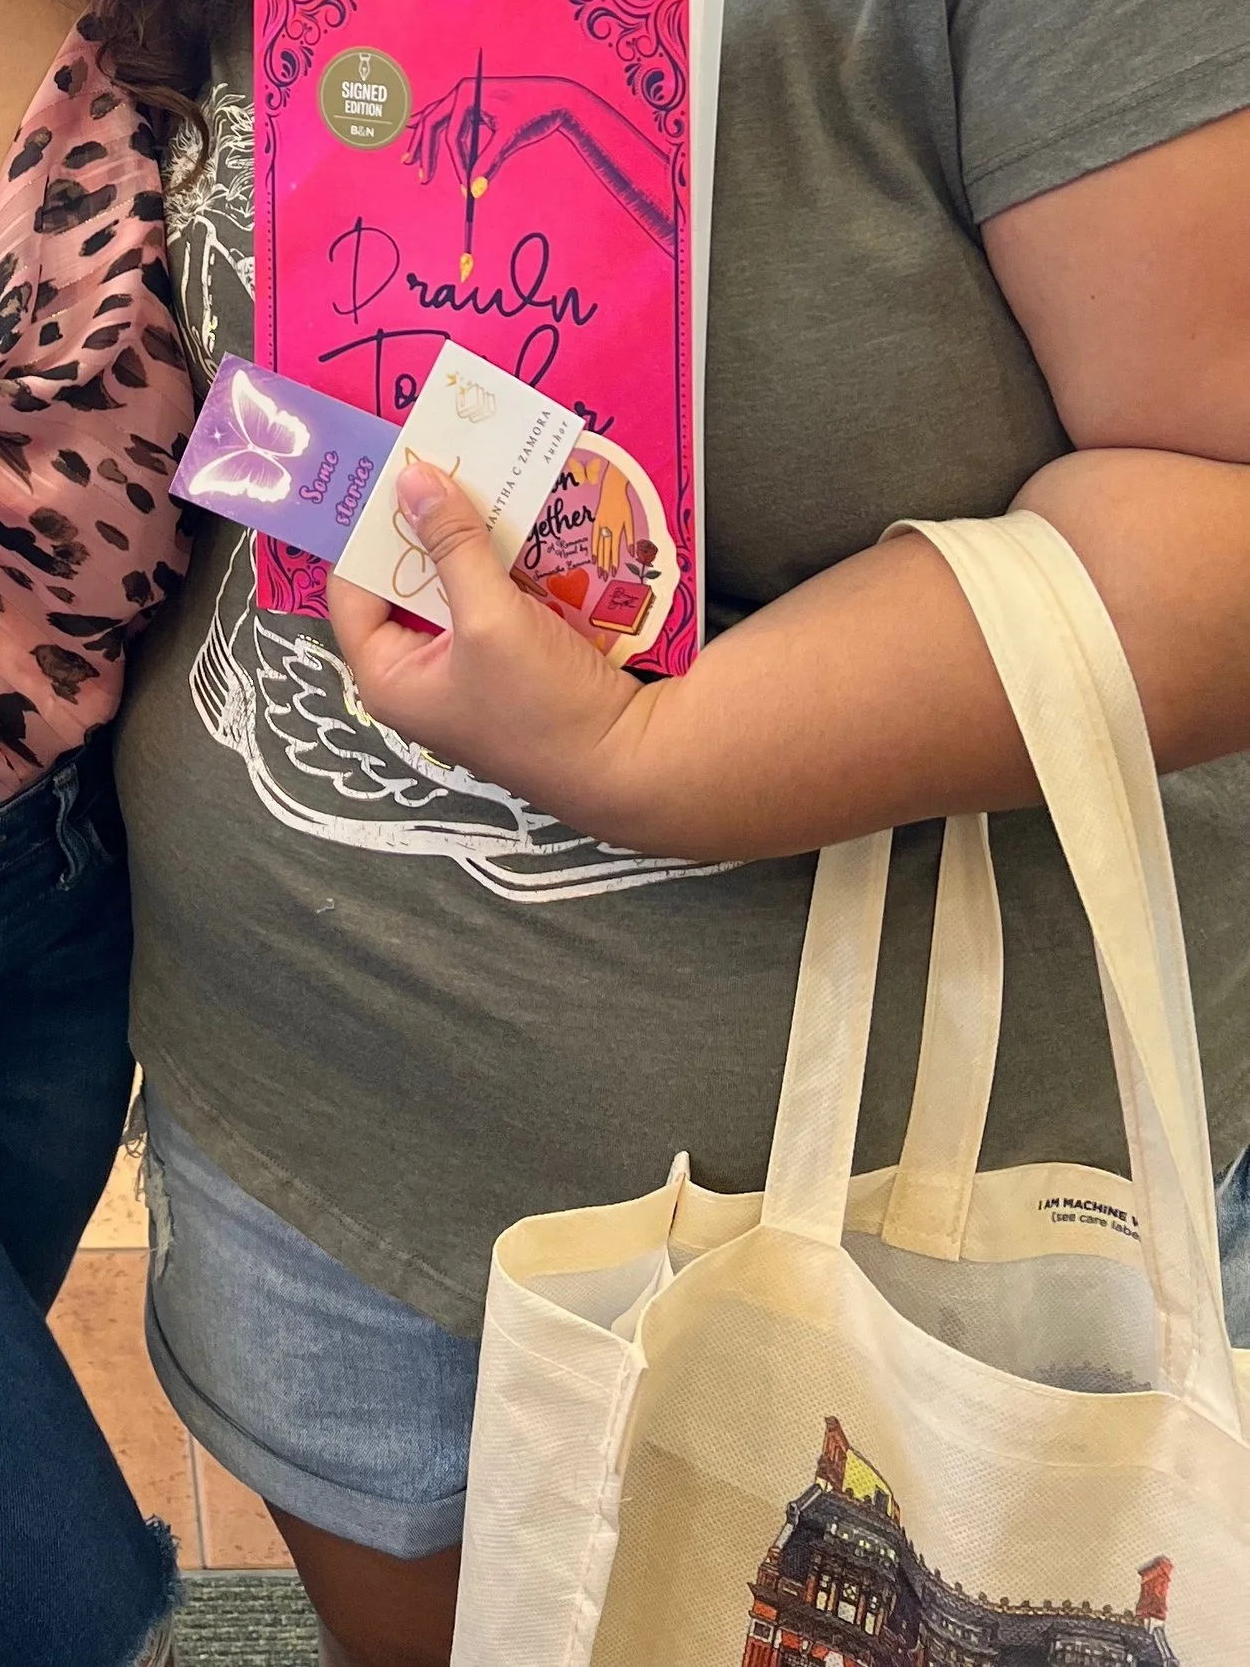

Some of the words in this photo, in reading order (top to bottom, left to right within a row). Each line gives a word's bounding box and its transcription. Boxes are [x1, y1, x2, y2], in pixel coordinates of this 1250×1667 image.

[341, 81, 388, 103] SIGNED
[344, 100, 383, 118] EDITION
[350, 125, 375, 137] B&N
[328, 216, 599, 325] Drawn
[543, 420, 569, 464] Author
[298, 450, 339, 505] Some
[335, 455, 374, 527] stories
[485, 480, 516, 532] MANTHA
[512, 466, 522, 476] C
[518, 410, 551, 464] ZAMORA
[524, 497, 596, 570] gether
[1038, 1200, 1043, 1211] I
[1044, 1198, 1060, 1210] AM
[1063, 1198, 1128, 1223] MACHINE
[1051, 1212, 1076, 1223] (see
[1079, 1214, 1108, 1227] care
